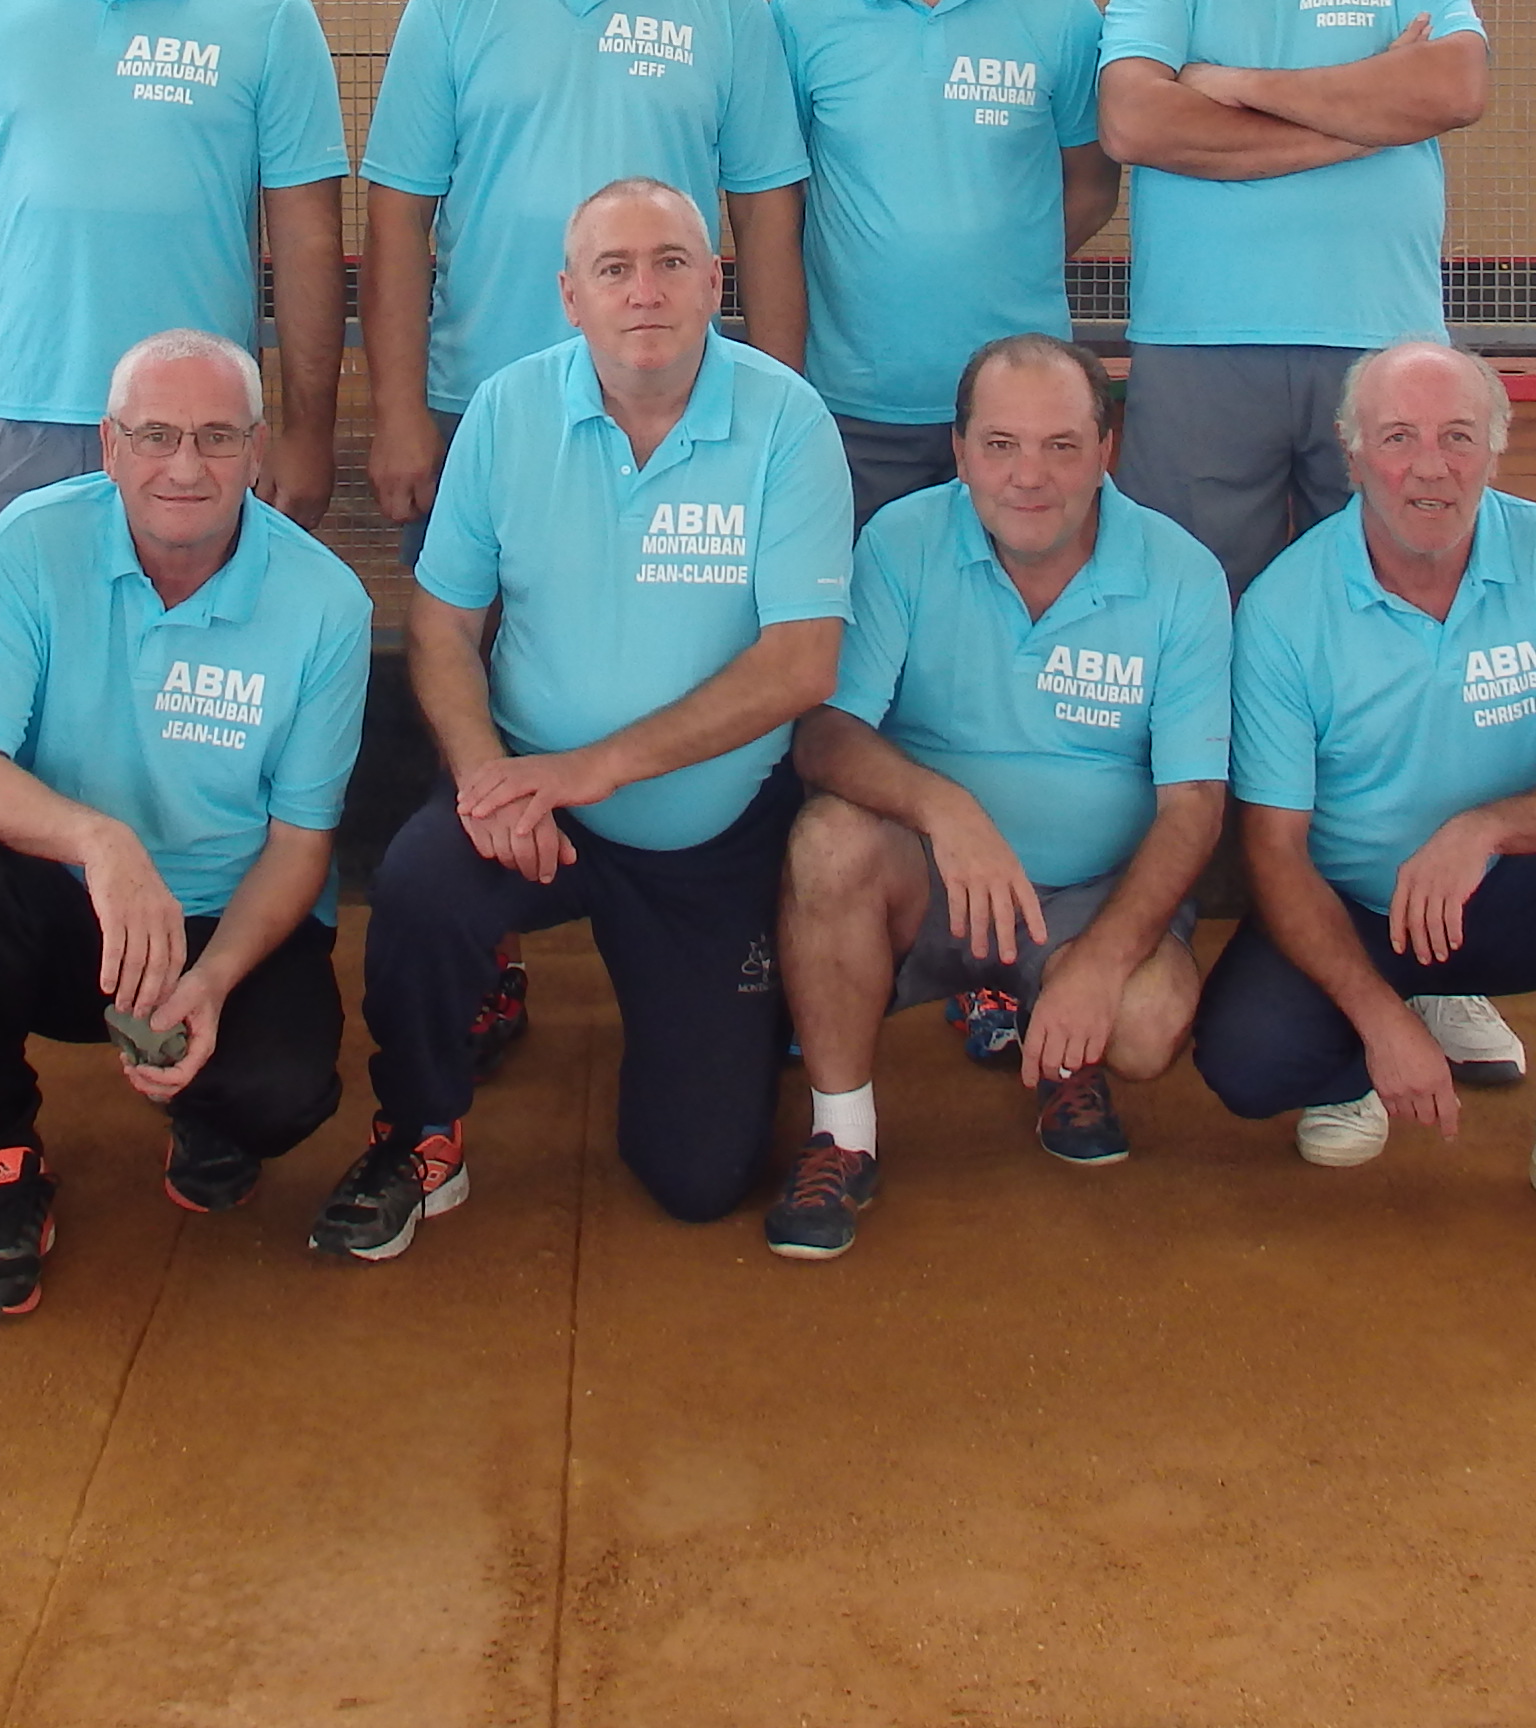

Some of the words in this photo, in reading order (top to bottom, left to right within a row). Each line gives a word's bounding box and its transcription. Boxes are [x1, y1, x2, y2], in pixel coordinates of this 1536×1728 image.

[604, 12, 694, 50] ABM
[1316, 12, 1376, 28] ROBERT
[124, 35, 221, 70] ABM
[598, 37, 694, 67] MONTAUBAN
[116, 60, 220, 87] MONTAUBAN
[628, 60, 666, 78] JEFF
[949, 55, 1036, 90] ABM
[133, 83, 194, 105] PASCAL
[944, 83, 1036, 106] MONTAUBAN
[974, 108, 1009, 126] ERIC
[648, 503, 745, 536] ABM
[642, 535, 747, 556] MONTAUBAN
[636, 564, 748, 584] JEAN-CLAUDE
[1044, 644, 1144, 686] ABM
[163, 660, 266, 706] ABM
[1037, 673, 1144, 705] MONTAUBAN
[154, 692, 264, 726] MONTAUBAN
[1055, 702, 1122, 728] CLAUDE
[162, 720, 247, 750] JEAN-LUC
